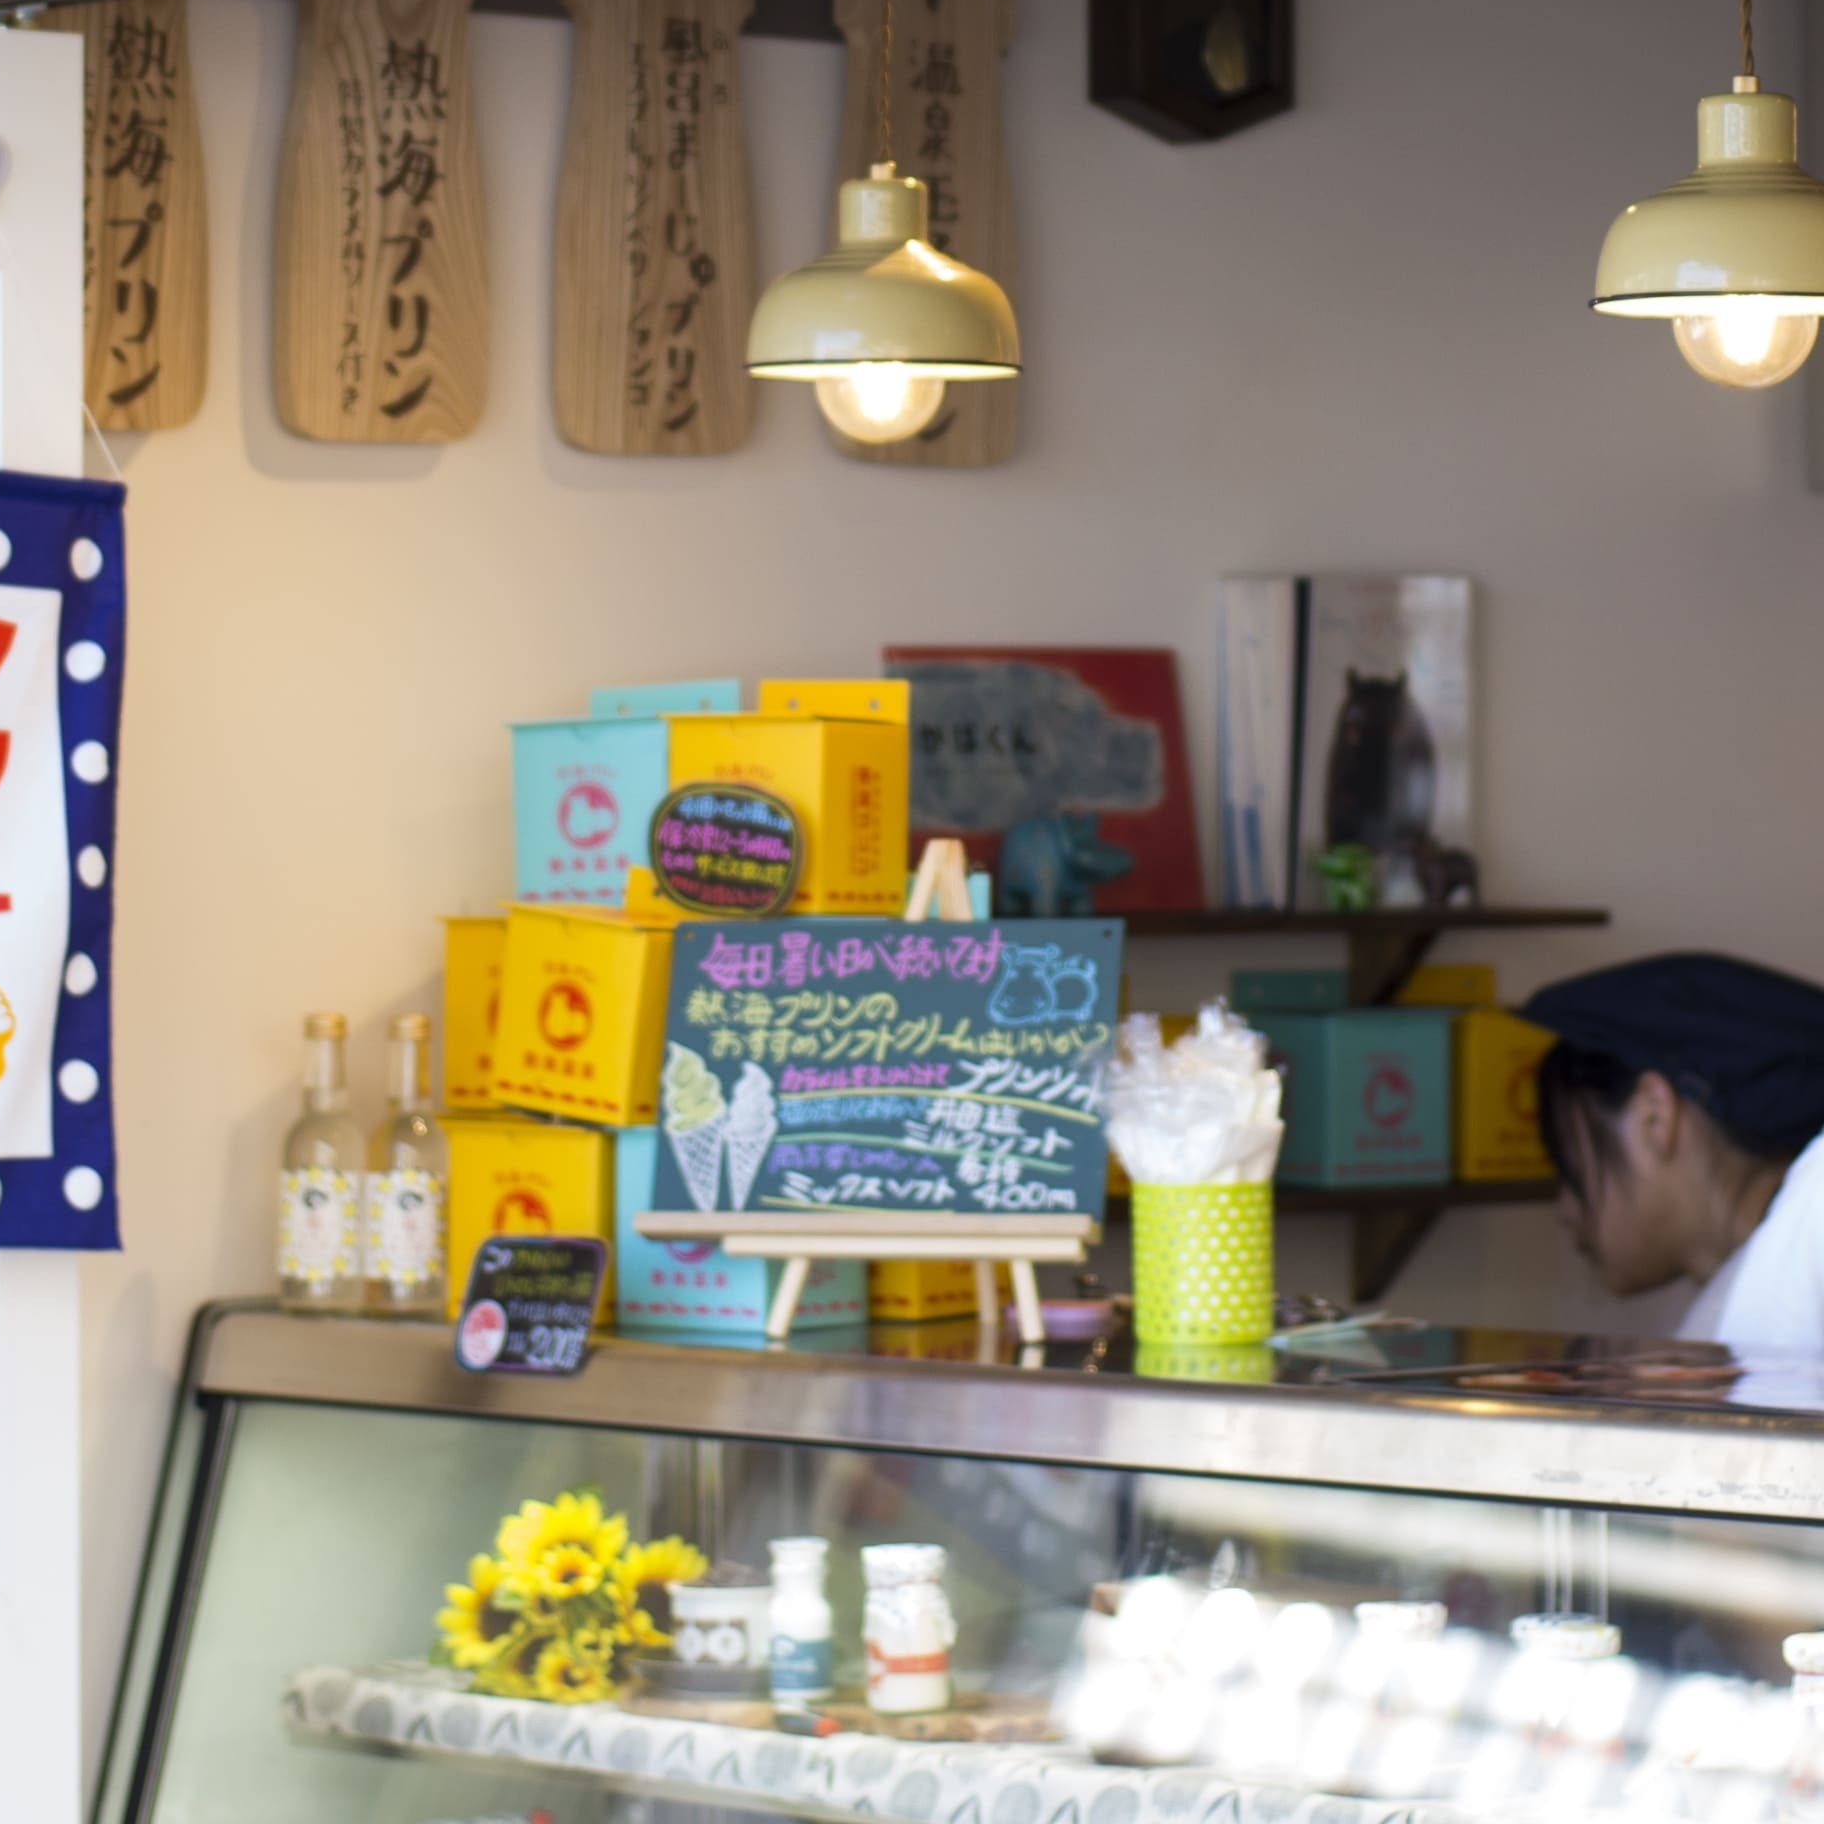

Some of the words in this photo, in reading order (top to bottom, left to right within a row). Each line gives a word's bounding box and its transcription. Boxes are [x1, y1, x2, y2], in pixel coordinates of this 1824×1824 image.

[105, 14, 176, 408] 熱海プリン
[379, 38, 448, 418] 熱海プリン
[685, 987, 897, 1027] 熱海プリンの
